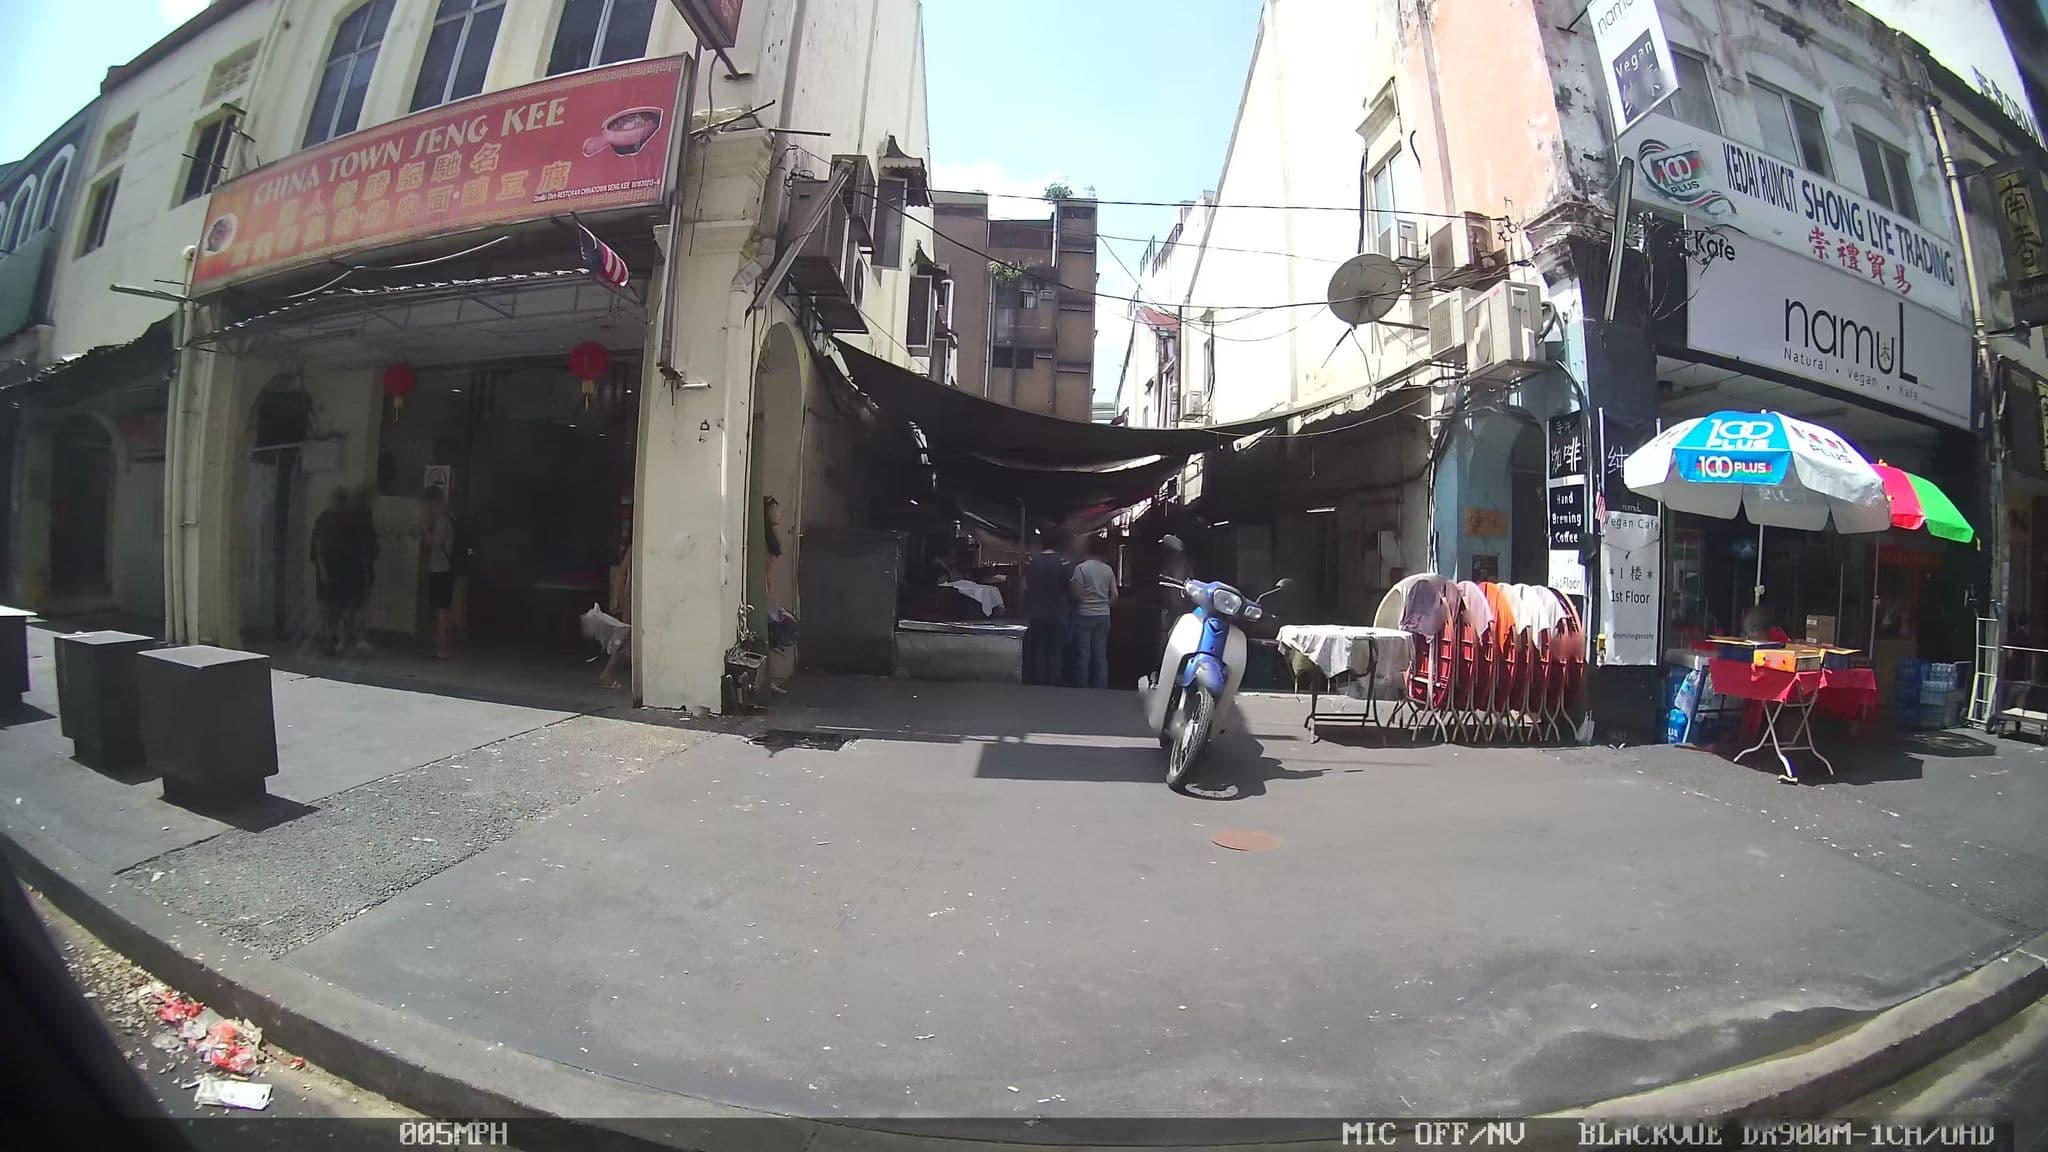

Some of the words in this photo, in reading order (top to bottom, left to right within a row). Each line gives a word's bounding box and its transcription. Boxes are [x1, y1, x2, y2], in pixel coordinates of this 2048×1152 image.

[1615, 40, 1652, 78] vegan
[254, 163, 320, 207] CHINA
[328, 137, 404, 182] TOWN
[409, 114, 489, 159] SENG
[500, 97, 568, 138] KEE
[1657, 154, 1693, 184] 100
[1670, 180, 1700, 194] PLUS
[1722, 142, 1761, 199] KEDAI
[1758, 156, 1799, 214] RUNCIT
[1801, 179, 1865, 242] SHONG
[1866, 209, 1895, 256] LYE
[1894, 223, 1955, 287] TRADING
[1693, 229, 1736, 261] Kafe
[1783, 347, 1829, 372] Natural
[1846, 367, 1878, 387] Vegan
[1707, 418, 1775, 440] 100
[1551, 435, 1583, 474] 咖啡
[1698, 455, 1733, 478] 100
[1734, 462, 1767, 474] PLUS
[1556, 490, 1574, 505] Hand
[1551, 511, 1582, 527] Brewing
[1637, 518, 1659, 531] Cafe
[1555, 530, 1579, 543] Coffee
[1610, 589, 1623, 603] 1st
[1625, 590, 1650, 604] Floor
